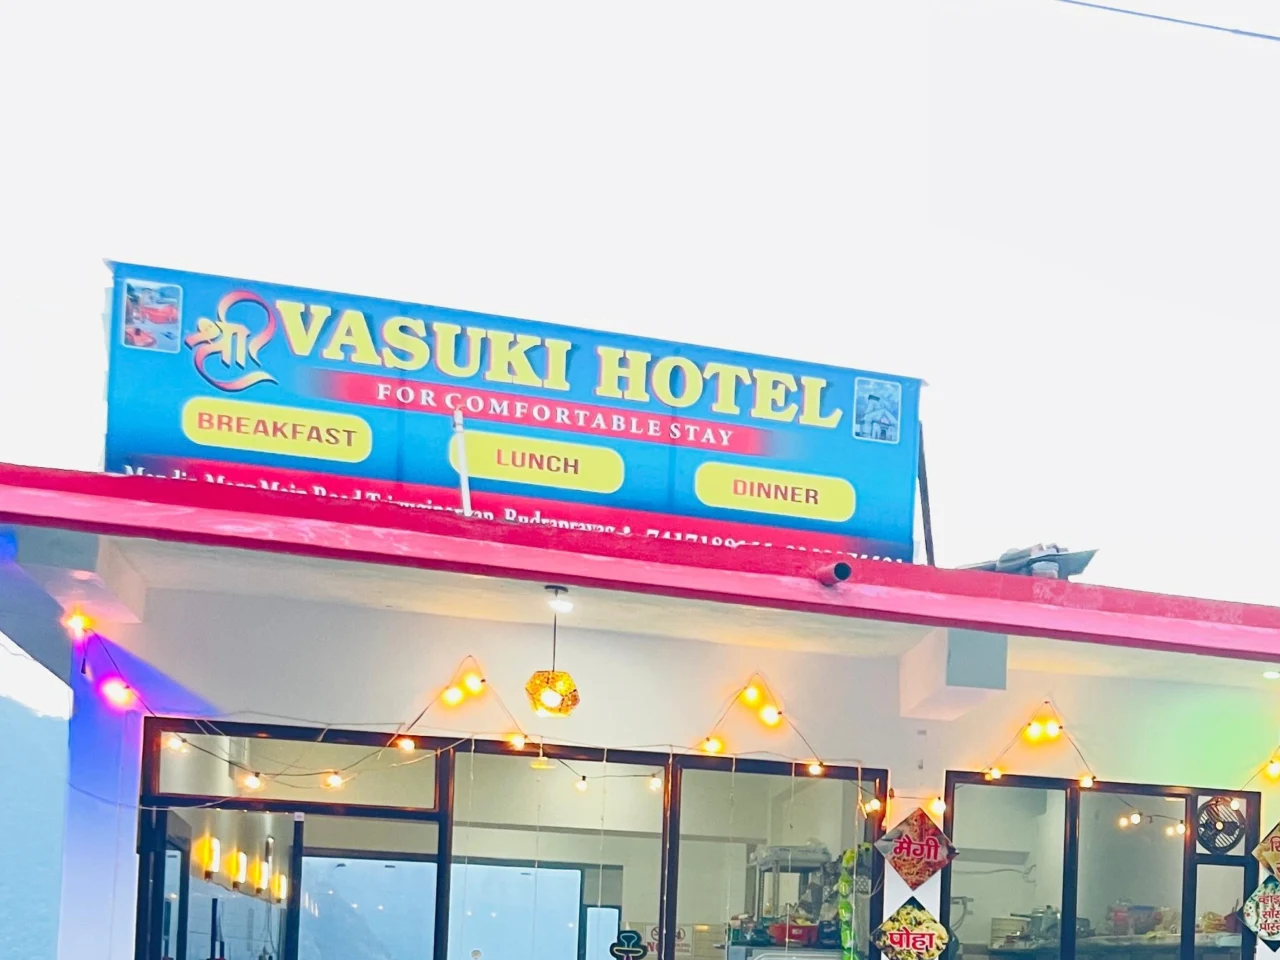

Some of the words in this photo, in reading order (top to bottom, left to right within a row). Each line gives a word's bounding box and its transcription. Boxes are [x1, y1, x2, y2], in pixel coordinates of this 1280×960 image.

[275, 300, 572, 391] VASUKI
[595, 346, 842, 429] HOTEL
[198, 411, 358, 447] BREAKFAST
[377, 384, 437, 407] FOR
[445, 393, 660, 437] COMFORTABLE
[669, 413, 734, 447] STAY
[496, 447, 579, 475] LUNCH
[733, 479, 820, 505] DINNER
[893, 834, 941, 860] मैगी
[888, 926, 936, 950] पोहा
